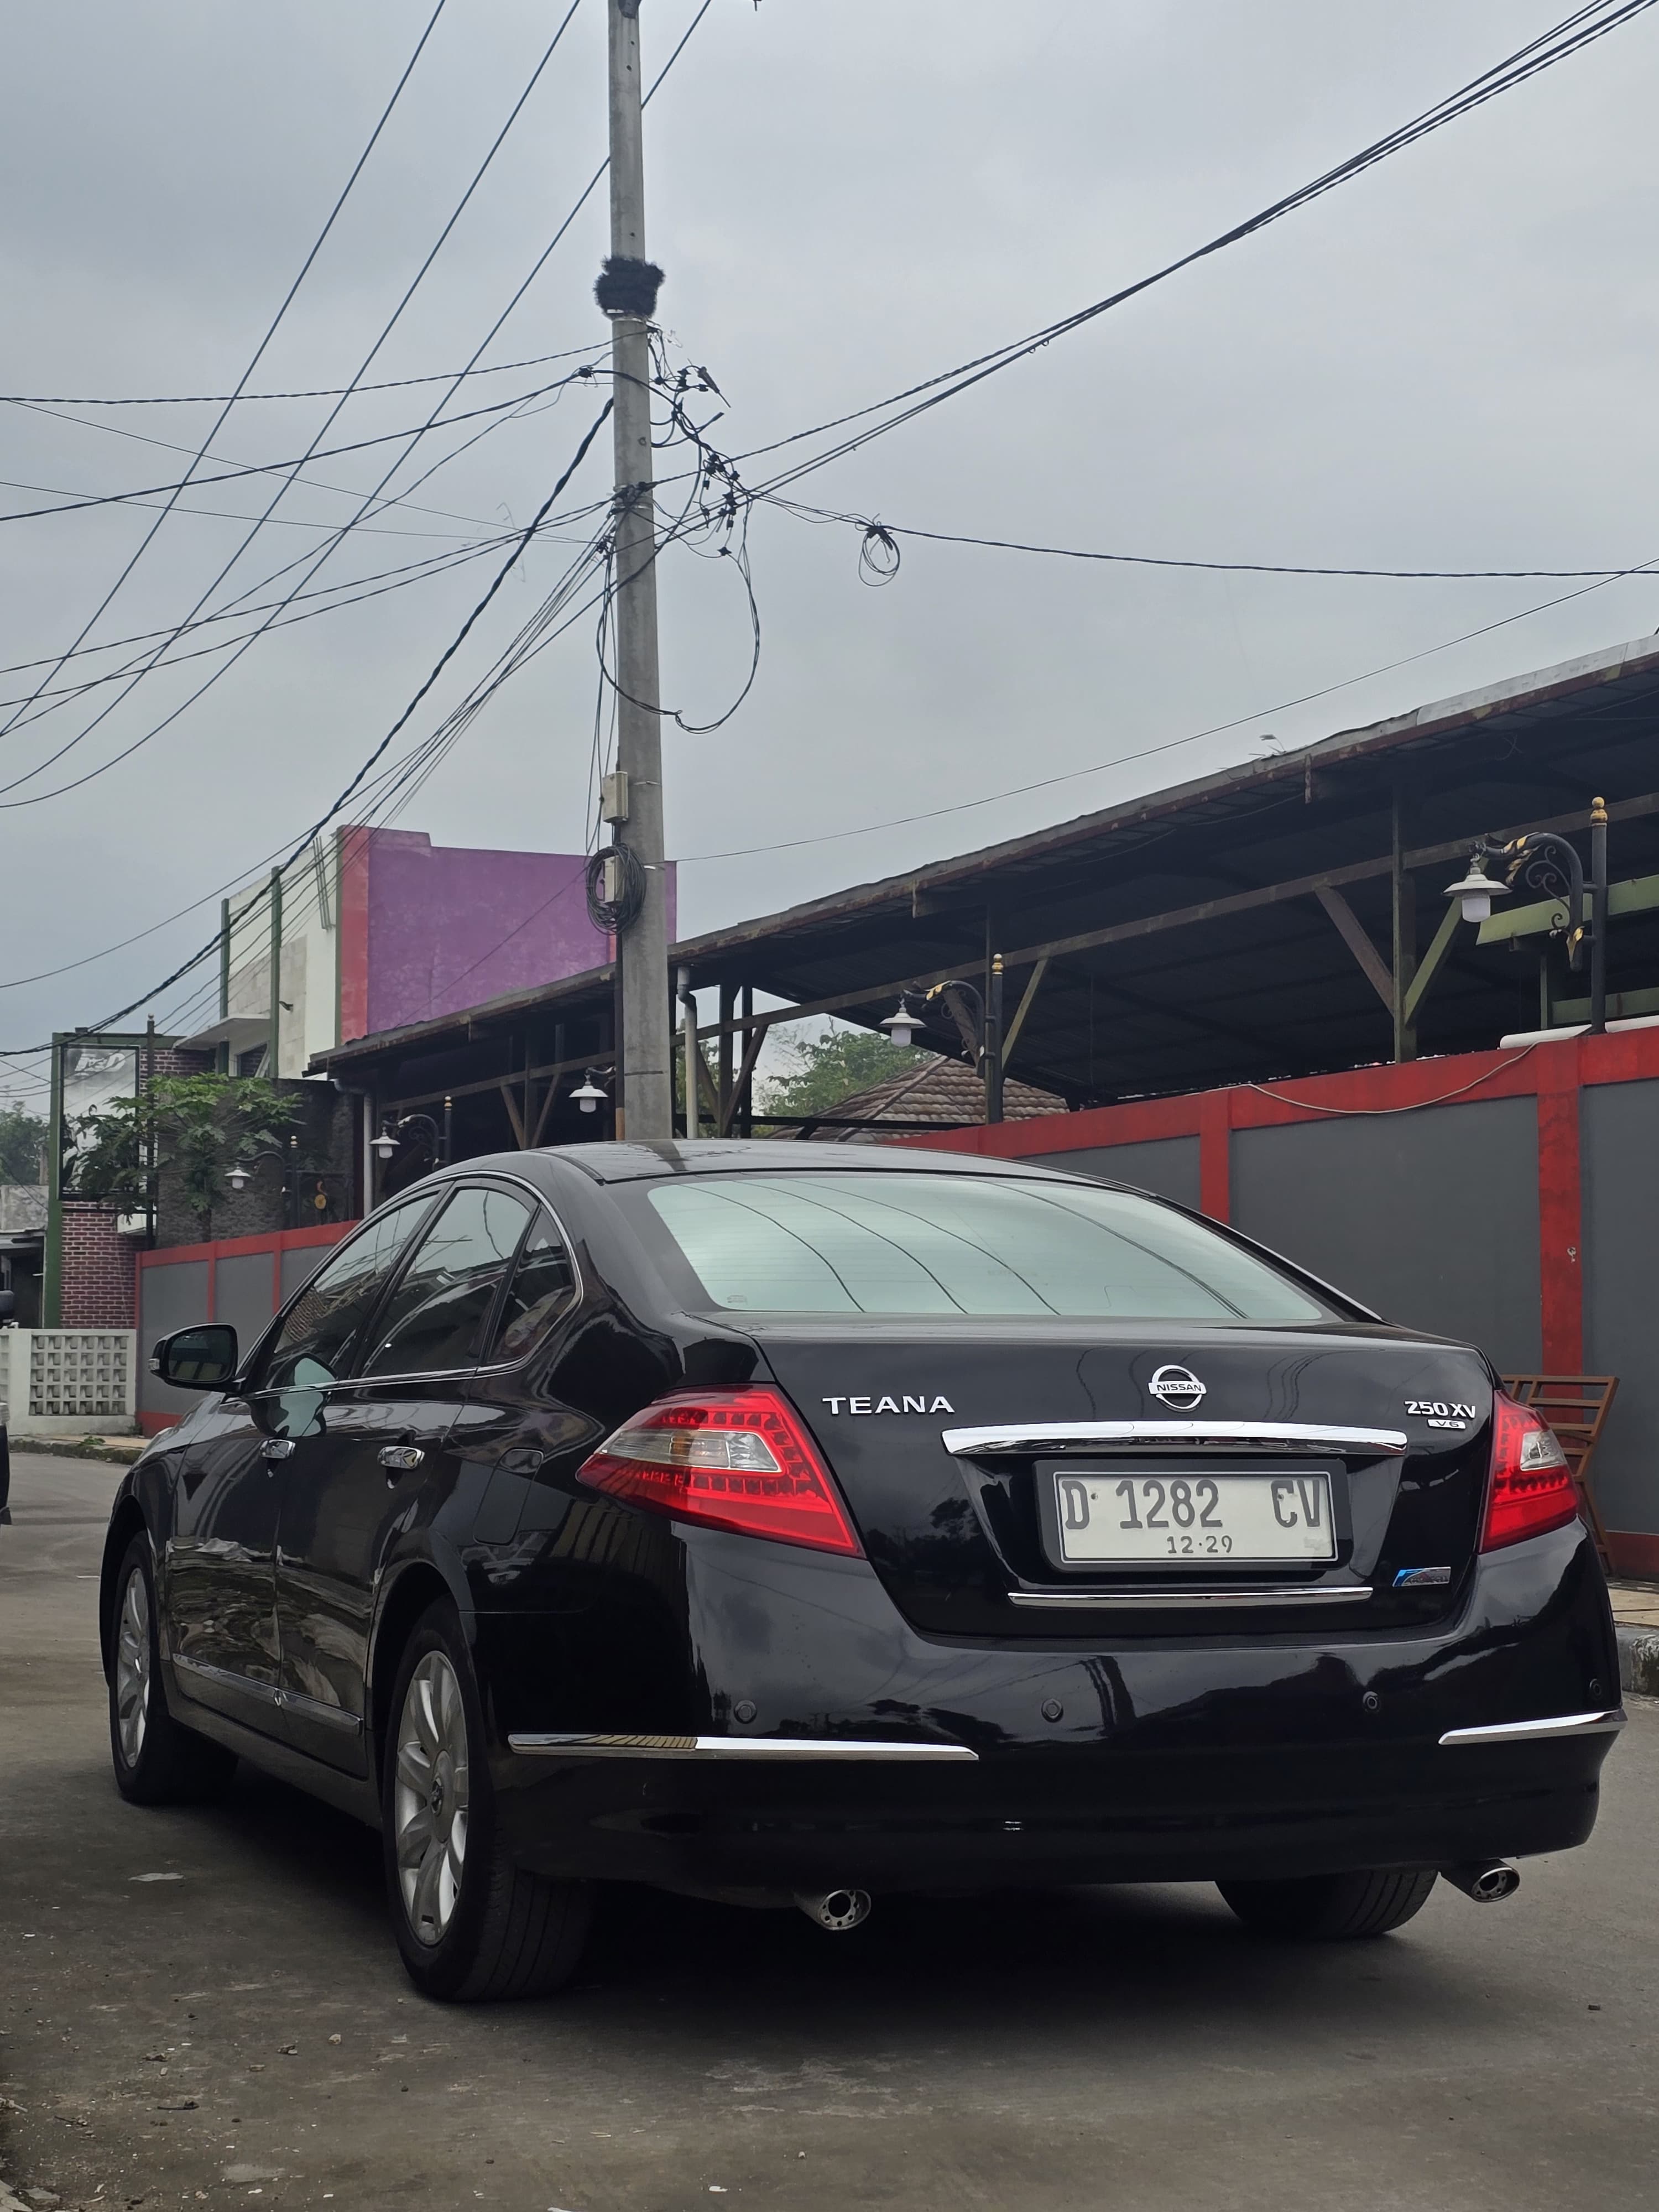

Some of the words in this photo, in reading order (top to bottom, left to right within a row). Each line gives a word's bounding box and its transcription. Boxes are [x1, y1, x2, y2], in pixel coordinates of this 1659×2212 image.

[822, 1396, 956, 1415] TEANA
[1061, 1480, 1090, 1530] D
[1115, 1479, 1223, 1529] 1282
[1270, 1479, 1321, 1528] CV
